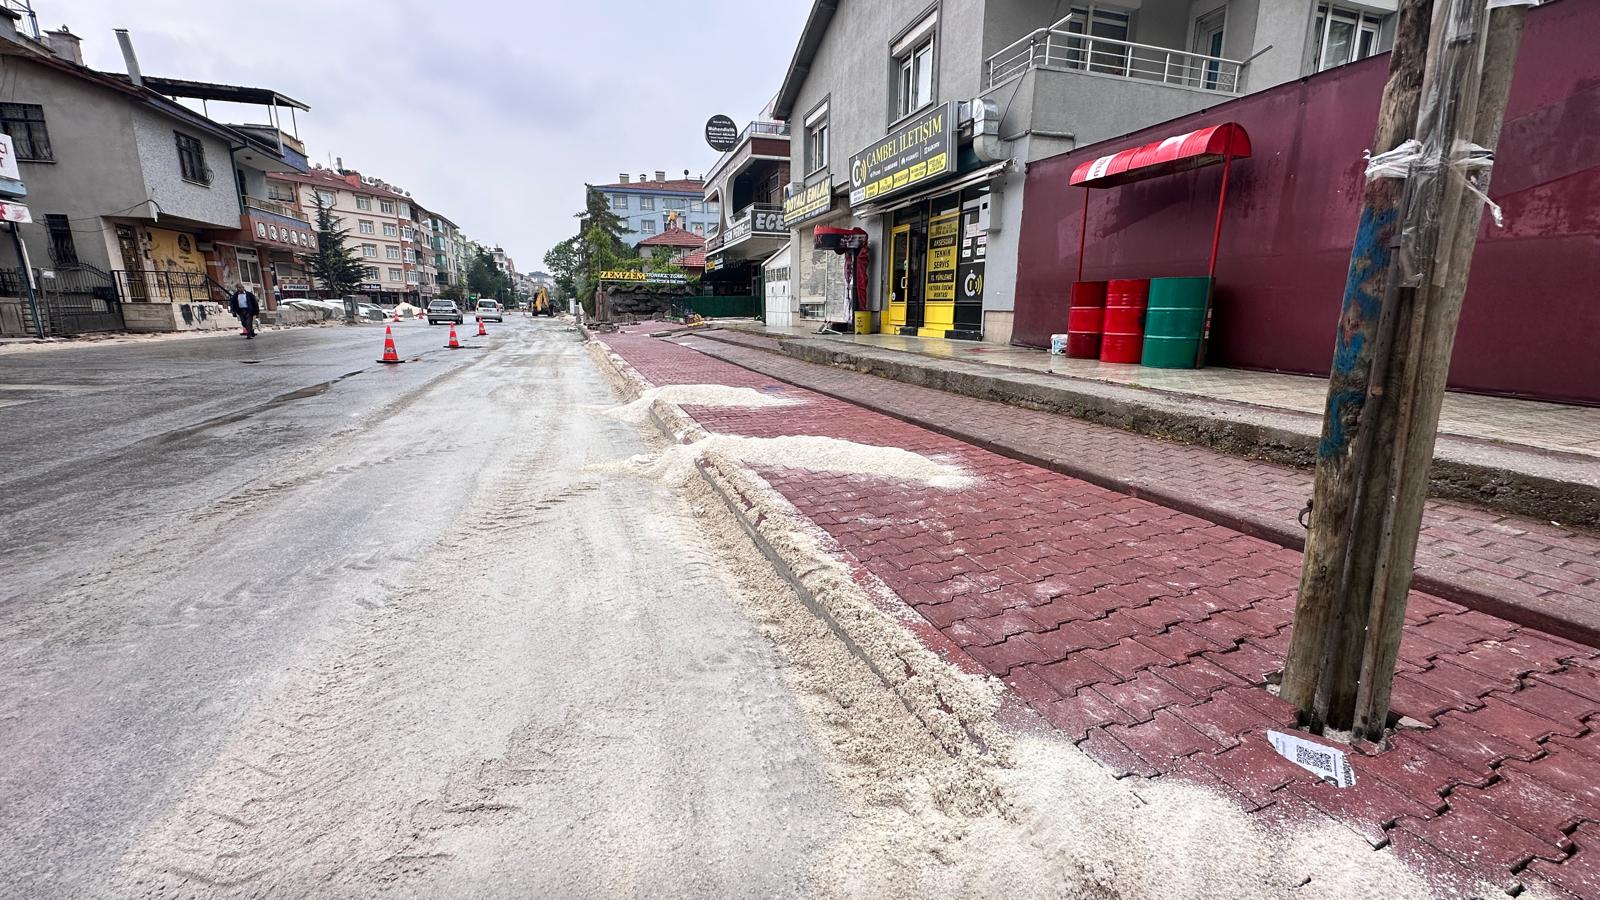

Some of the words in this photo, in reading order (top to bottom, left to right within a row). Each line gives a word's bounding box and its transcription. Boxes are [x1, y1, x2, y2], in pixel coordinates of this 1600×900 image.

[867, 139, 898, 172] ÇAMBEL
[899, 114, 943, 152] İLETİŞİM
[600, 271, 645, 279] ZEMZEM
